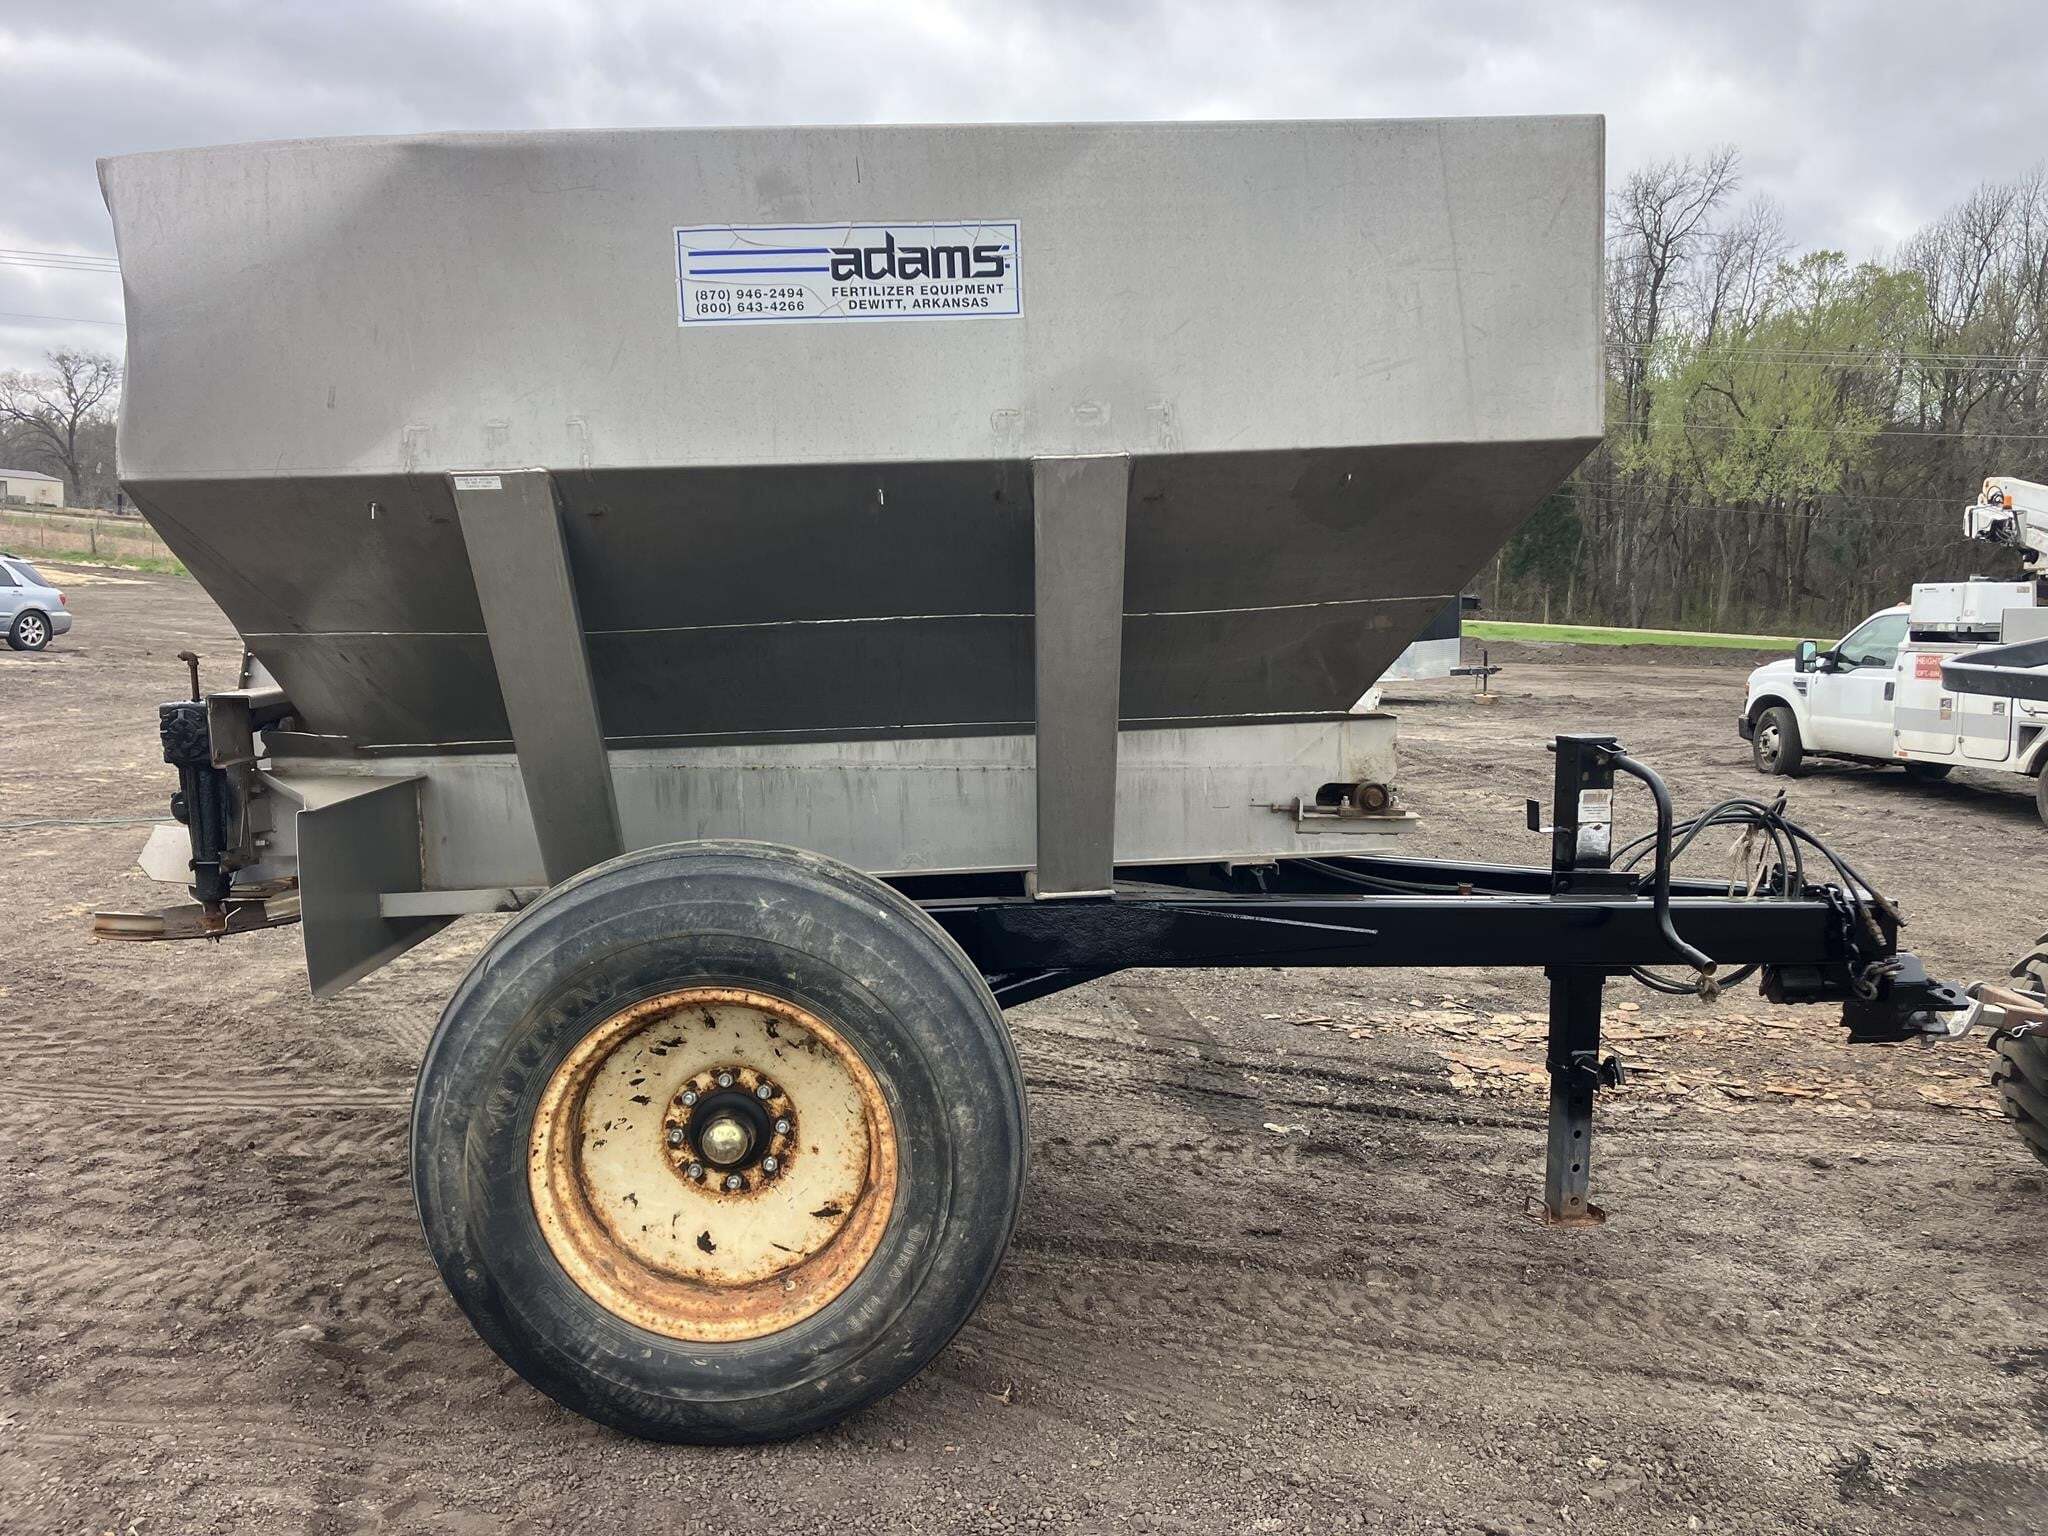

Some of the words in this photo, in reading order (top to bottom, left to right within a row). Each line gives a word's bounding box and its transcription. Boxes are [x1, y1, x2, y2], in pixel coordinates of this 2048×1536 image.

[831, 230, 1005, 281] adams
[695, 288, 731, 302] (870)
[736, 287, 804, 300] 946-2494
[831, 285, 915, 297] FERTILIZER
[920, 283, 1004, 296] EQUIPMENT
[696, 302, 731, 315] (800)
[737, 300, 805, 313] 643-4266
[848, 299, 907, 311] DEWITT,
[912, 297, 989, 309] ARKANSAS
